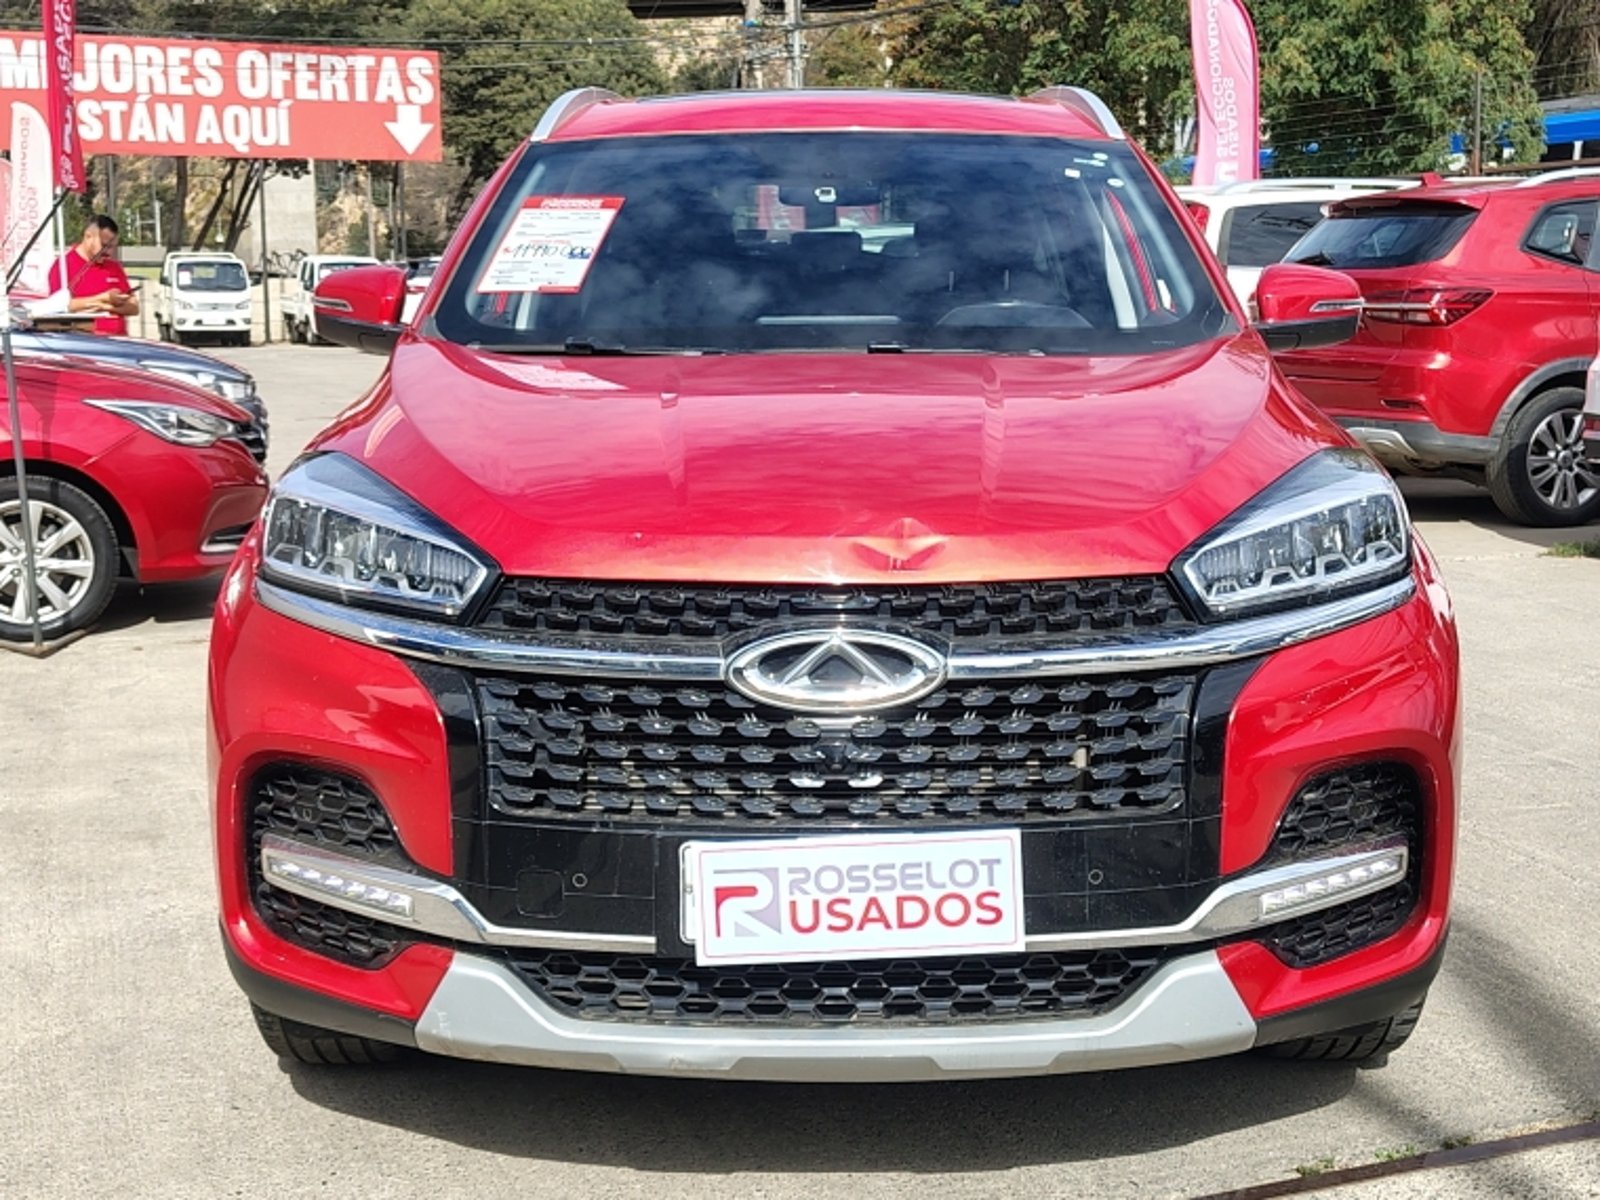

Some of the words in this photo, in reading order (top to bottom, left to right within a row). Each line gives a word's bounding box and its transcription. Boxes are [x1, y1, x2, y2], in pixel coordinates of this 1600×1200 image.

[236, 50, 434, 105] OFERTAS
[77, 95, 186, 143] STÁN
[195, 99, 294, 153] AQUÍ
[787, 858, 1002, 896] ROSSELOT
[789, 891, 1003, 934] USADOS
